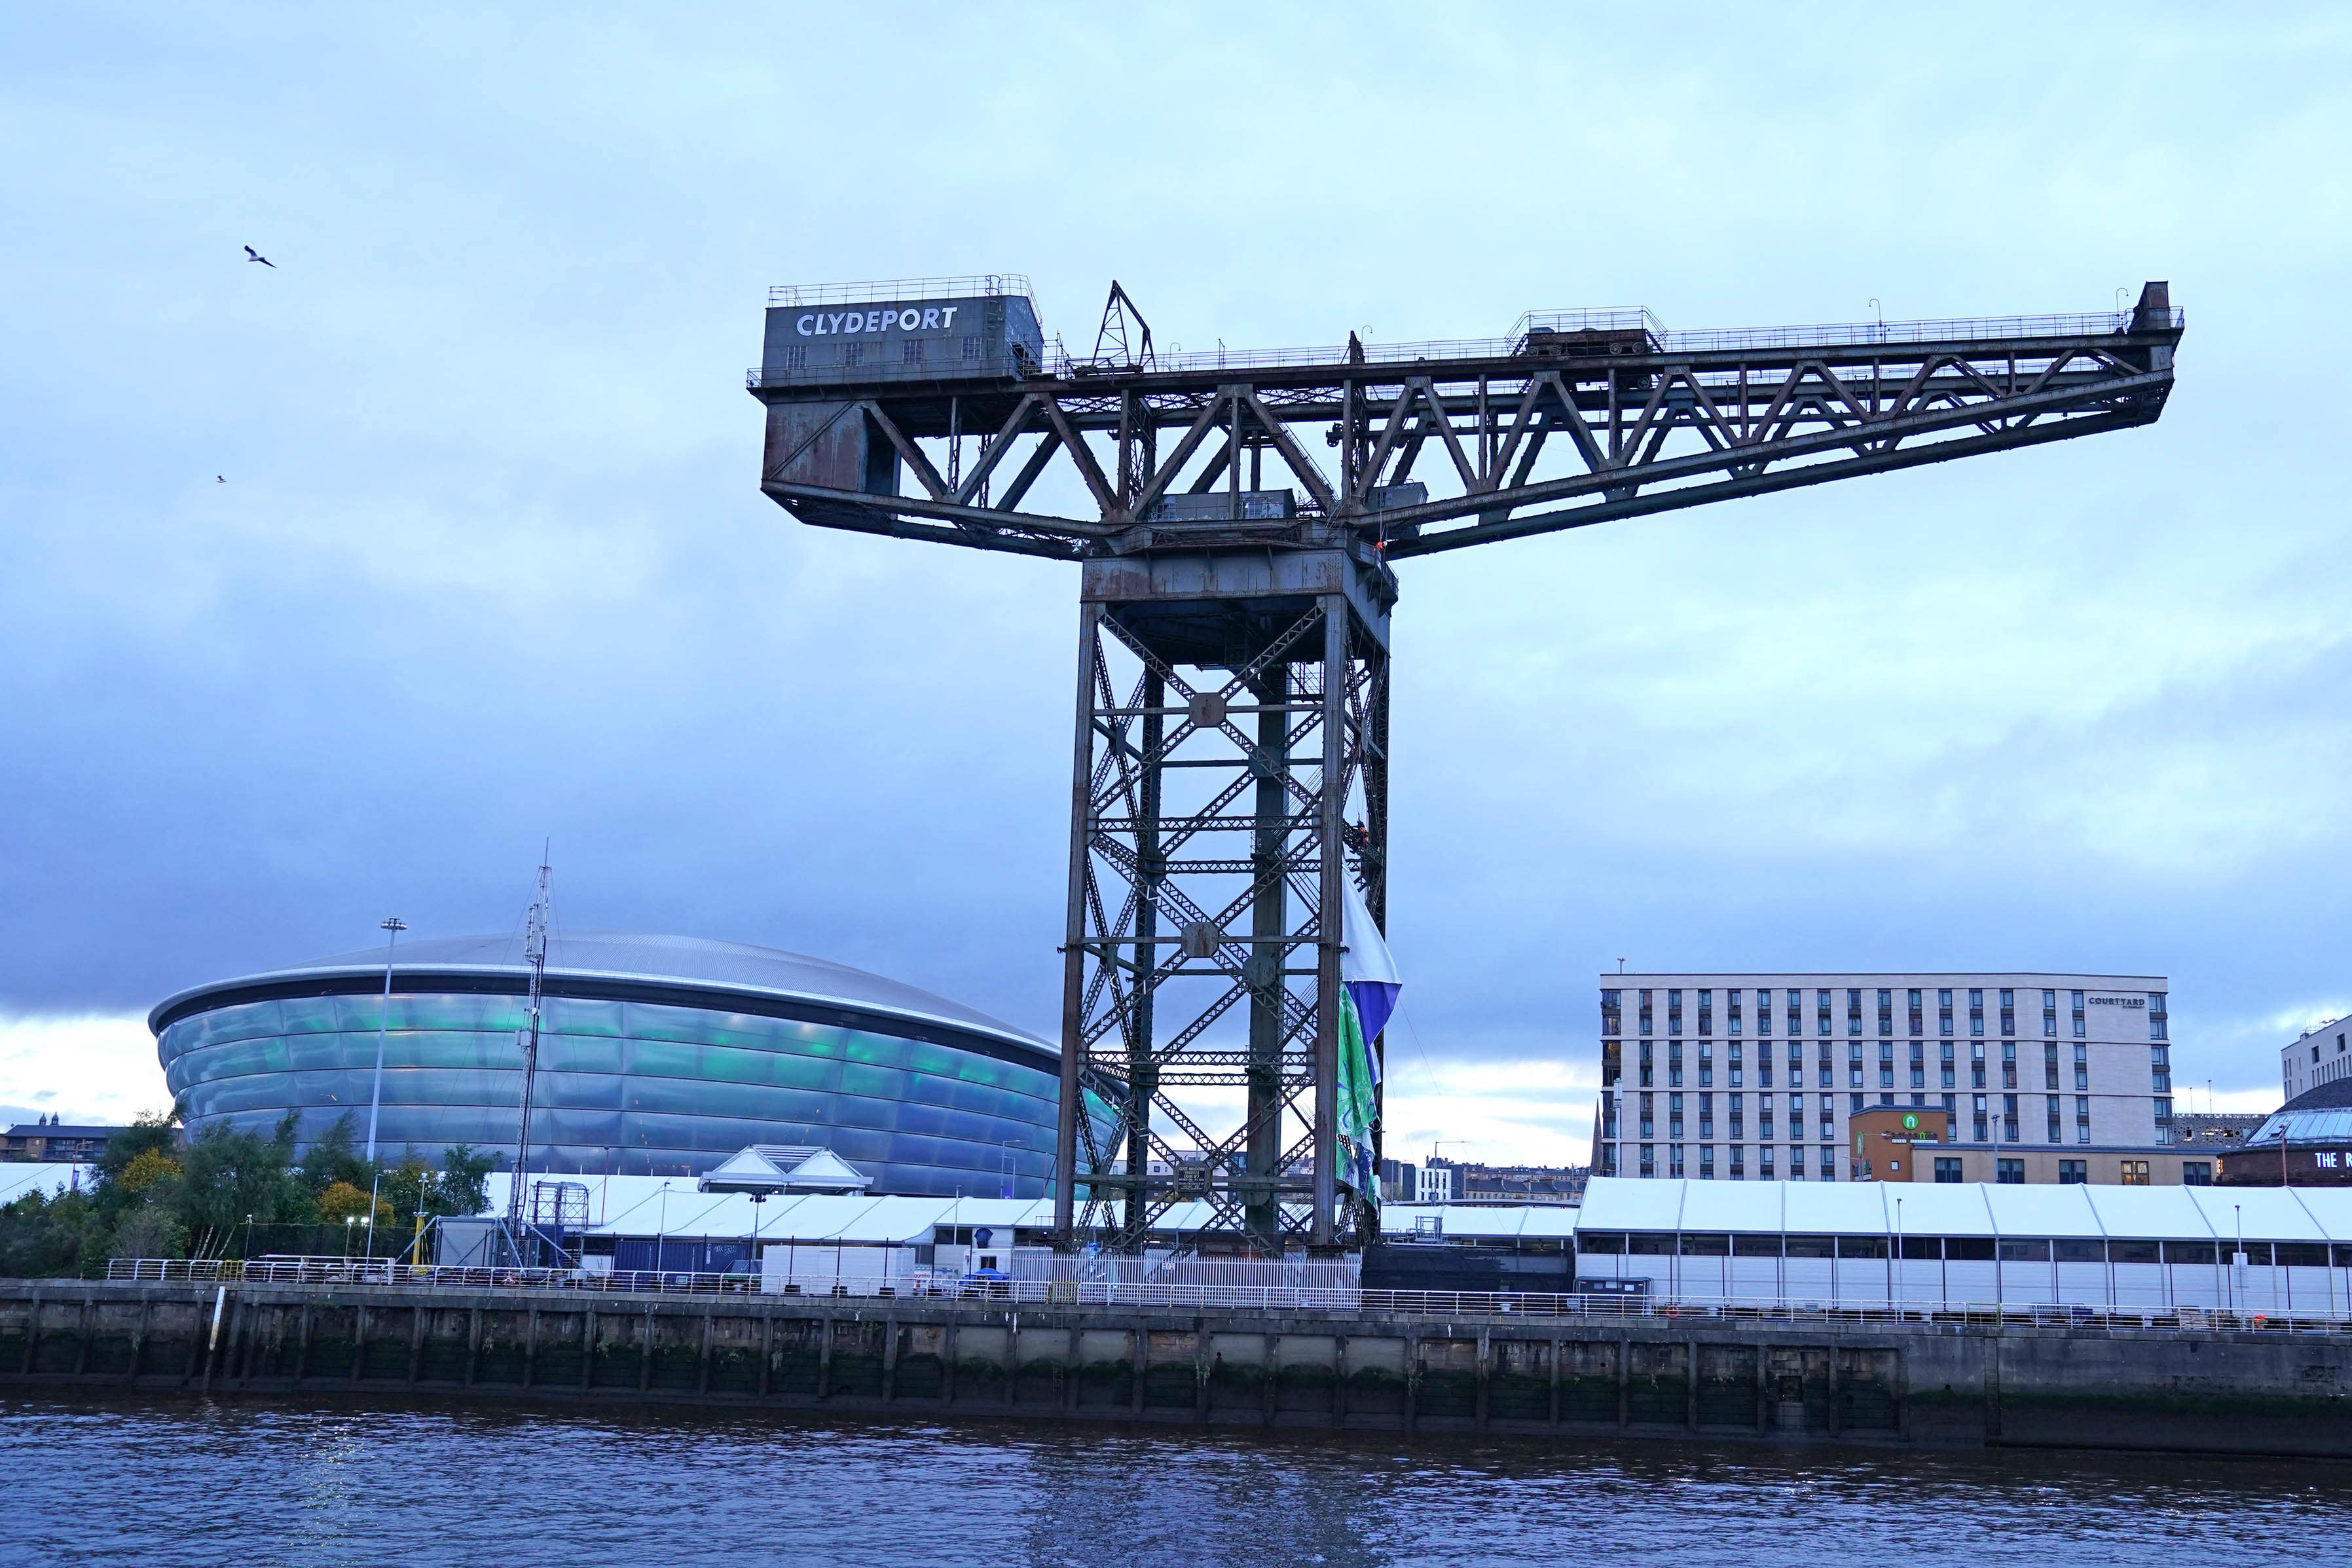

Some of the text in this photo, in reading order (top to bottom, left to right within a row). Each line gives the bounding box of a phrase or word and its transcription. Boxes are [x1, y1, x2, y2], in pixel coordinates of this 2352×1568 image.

[797, 307, 957, 337] CLYDEPORT
[2089, 997, 2144, 1006] COURTYARD
[2315, 1152, 2337, 1168] THE
